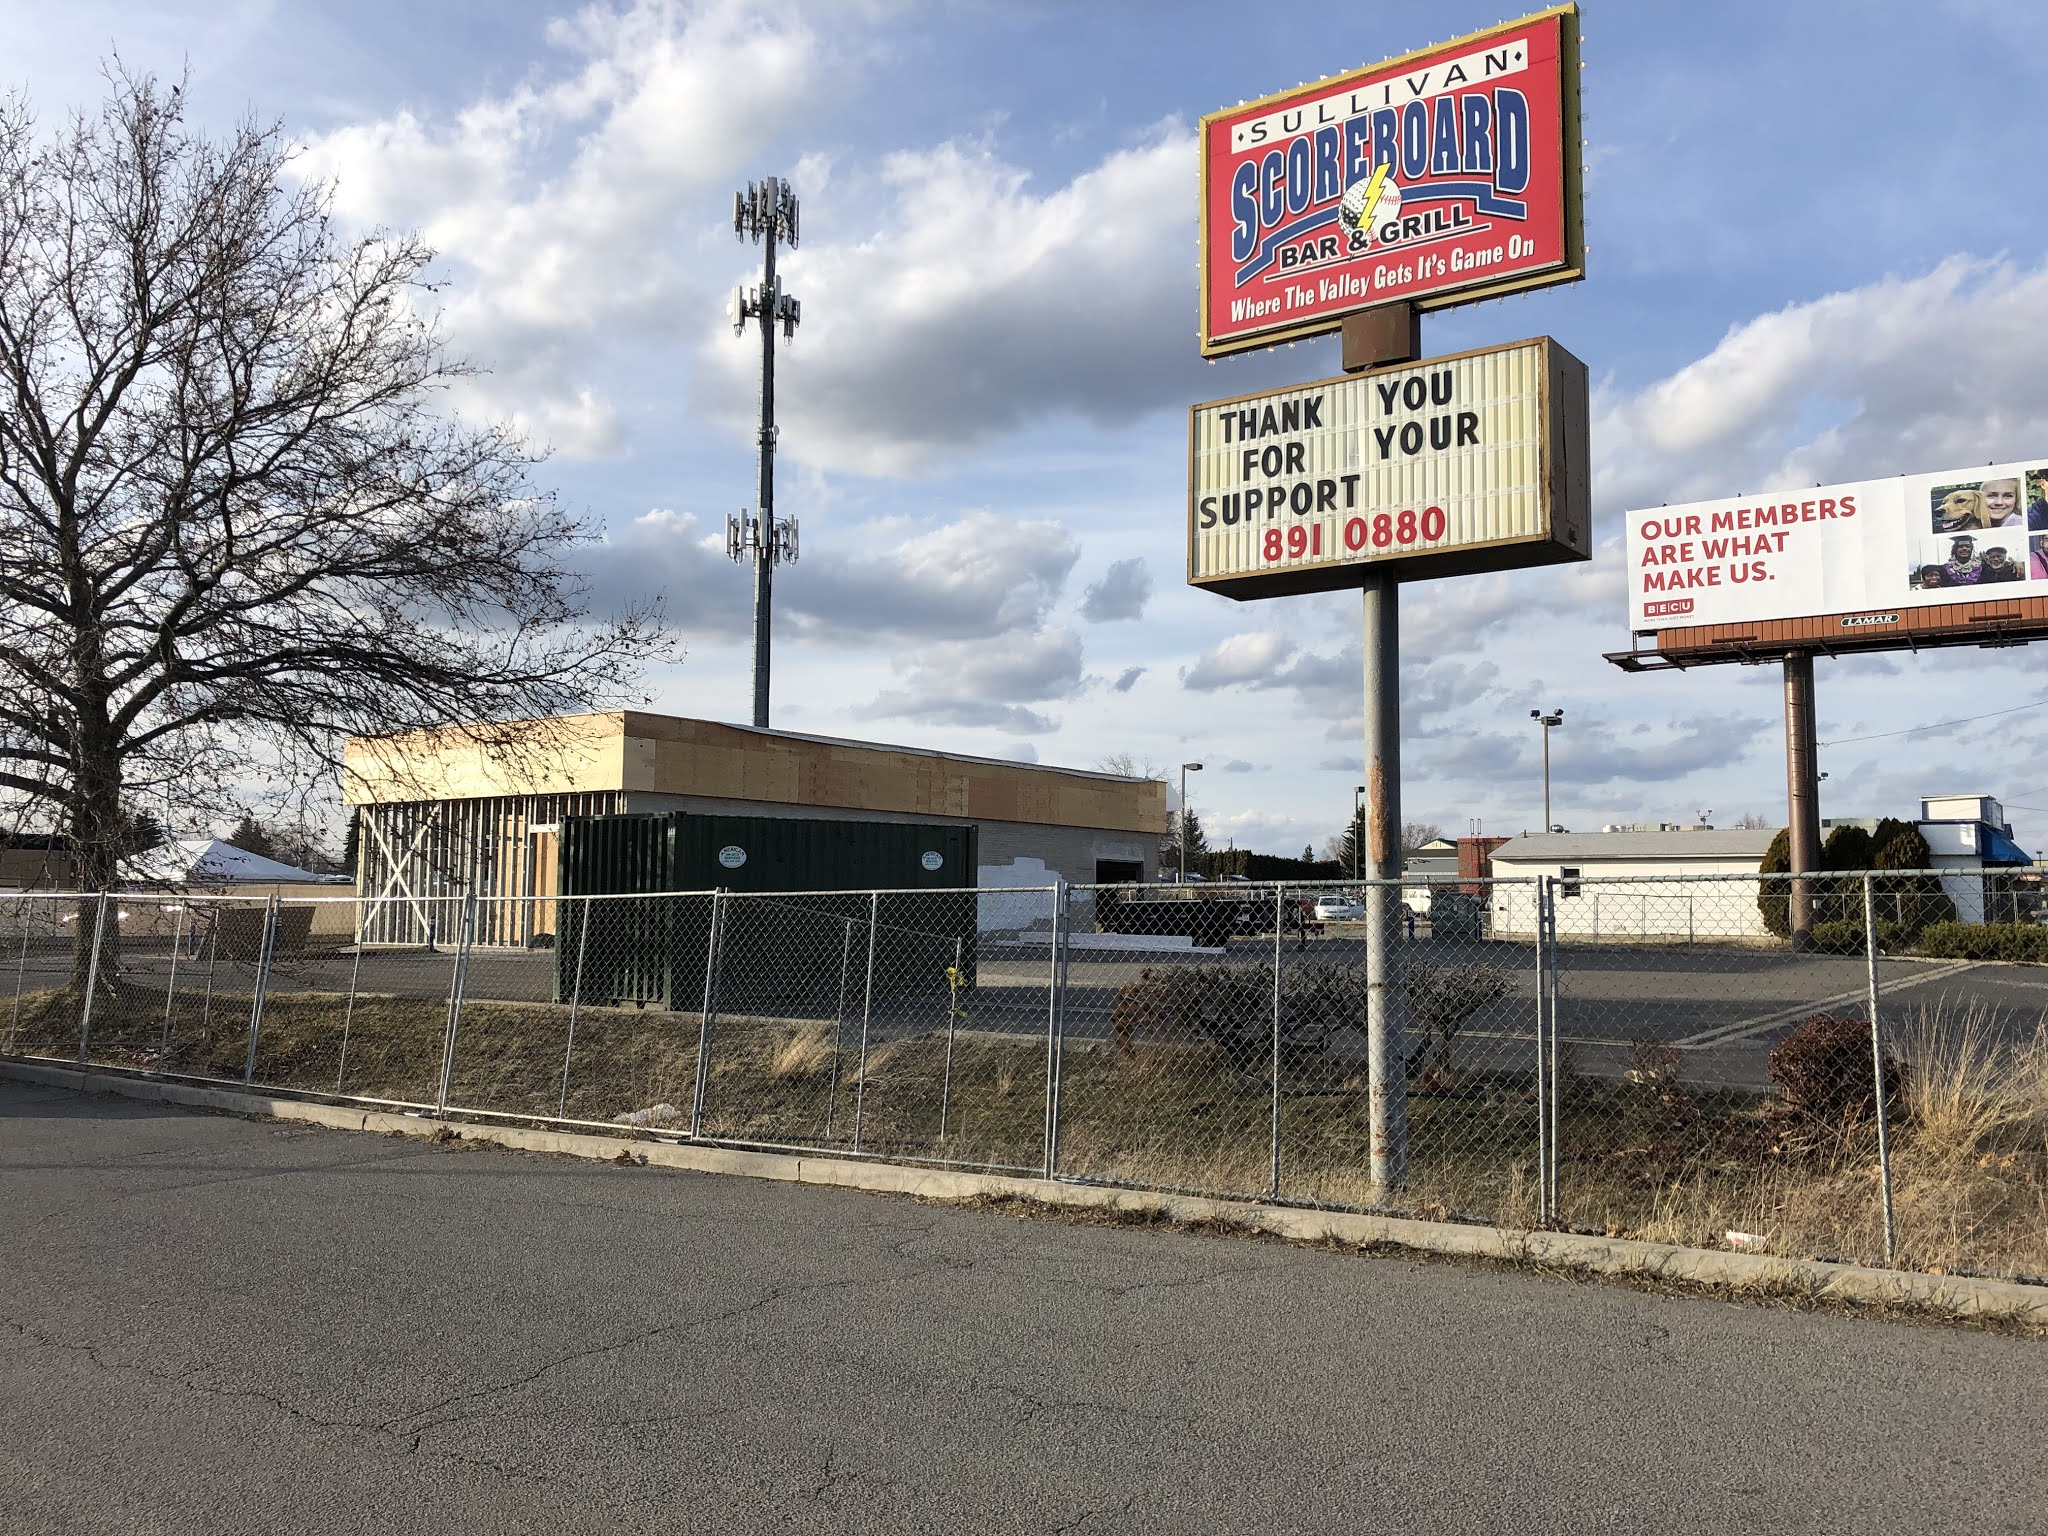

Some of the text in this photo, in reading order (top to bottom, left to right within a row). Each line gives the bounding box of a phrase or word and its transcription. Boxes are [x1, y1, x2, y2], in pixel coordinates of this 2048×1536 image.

[1250, 48, 1507, 143] SULLIVAN
[1231, 87, 1531, 262] SCOREBOARD
[1280, 205, 1471, 270] BAR & GRILL
[1231, 234, 1535, 323] Where The Valley Gets It's Game On
[1219, 370, 1453, 444] THANK YOU
[1242, 411, 1480, 481] FOR YOUR
[1199, 474, 1360, 529] SUPPORT
[1641, 496, 1856, 540] OUR MEMBERS
[1263, 506, 1446, 561] 891 0880
[1641, 531, 1790, 567] ARE WHAT
[1643, 561, 1775, 593] MAKE US.
[1647, 601, 1690, 614] BECU
[1847, 614, 1893, 626] LAMAR
